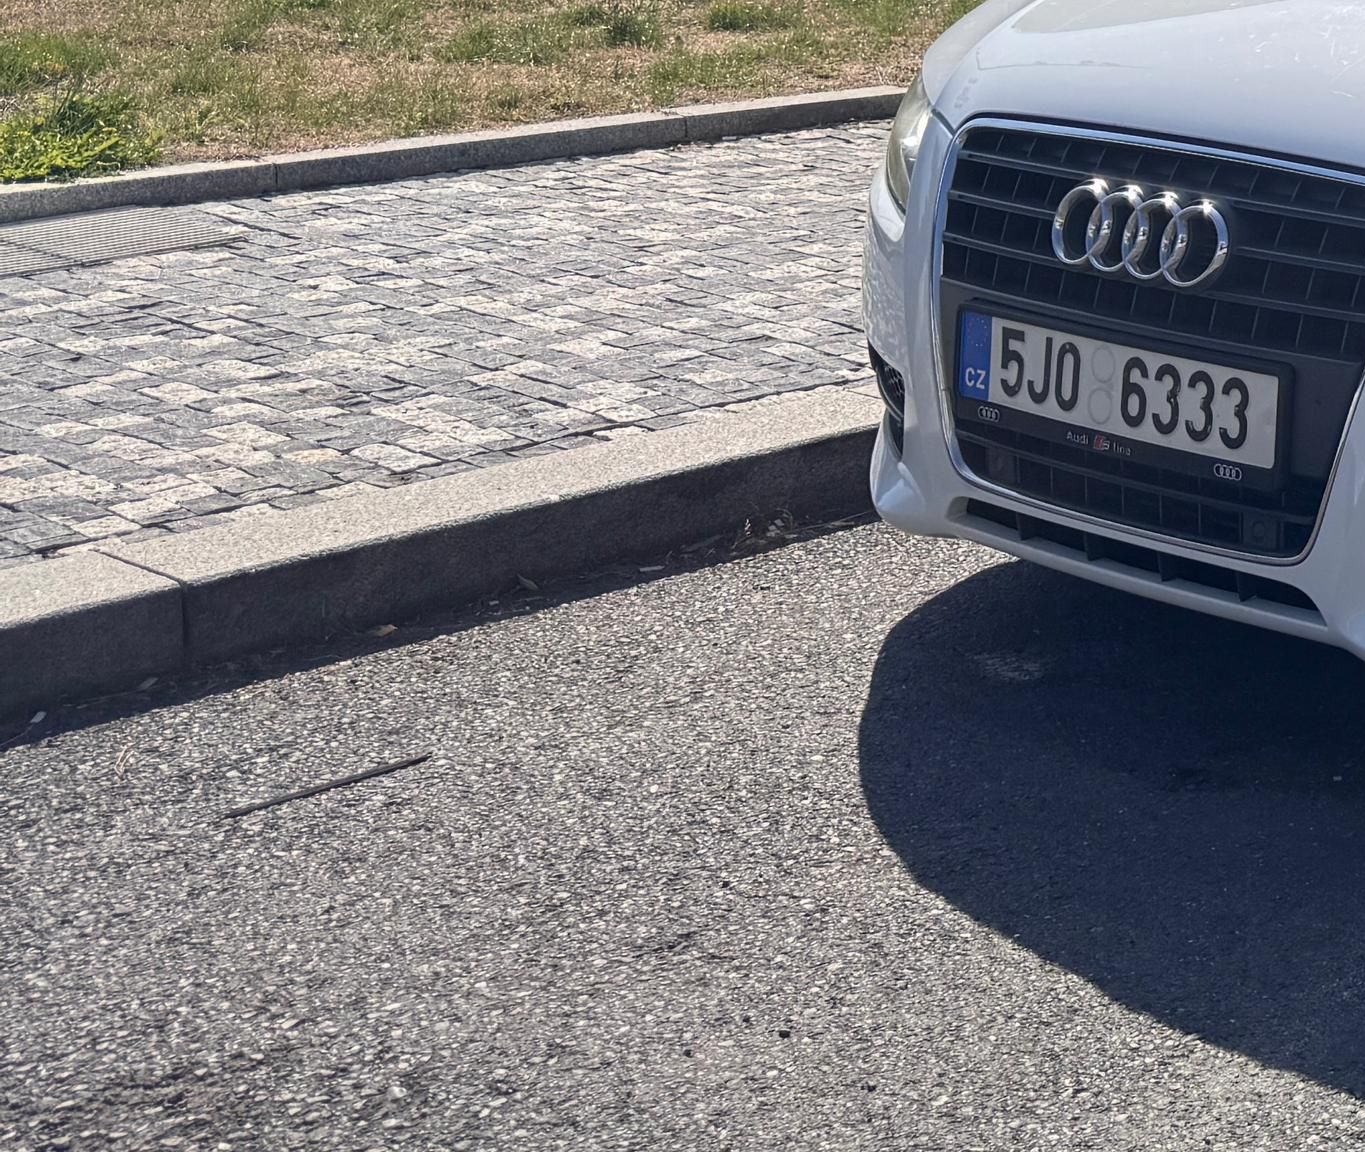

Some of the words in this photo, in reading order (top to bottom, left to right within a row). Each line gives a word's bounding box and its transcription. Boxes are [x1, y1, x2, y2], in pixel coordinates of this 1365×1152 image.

[965, 367, 986, 390] CZ
[1000, 326, 1081, 412] 5J0
[1120, 356, 1250, 450] 6333
[1066, 431, 1089, 445] Audi
